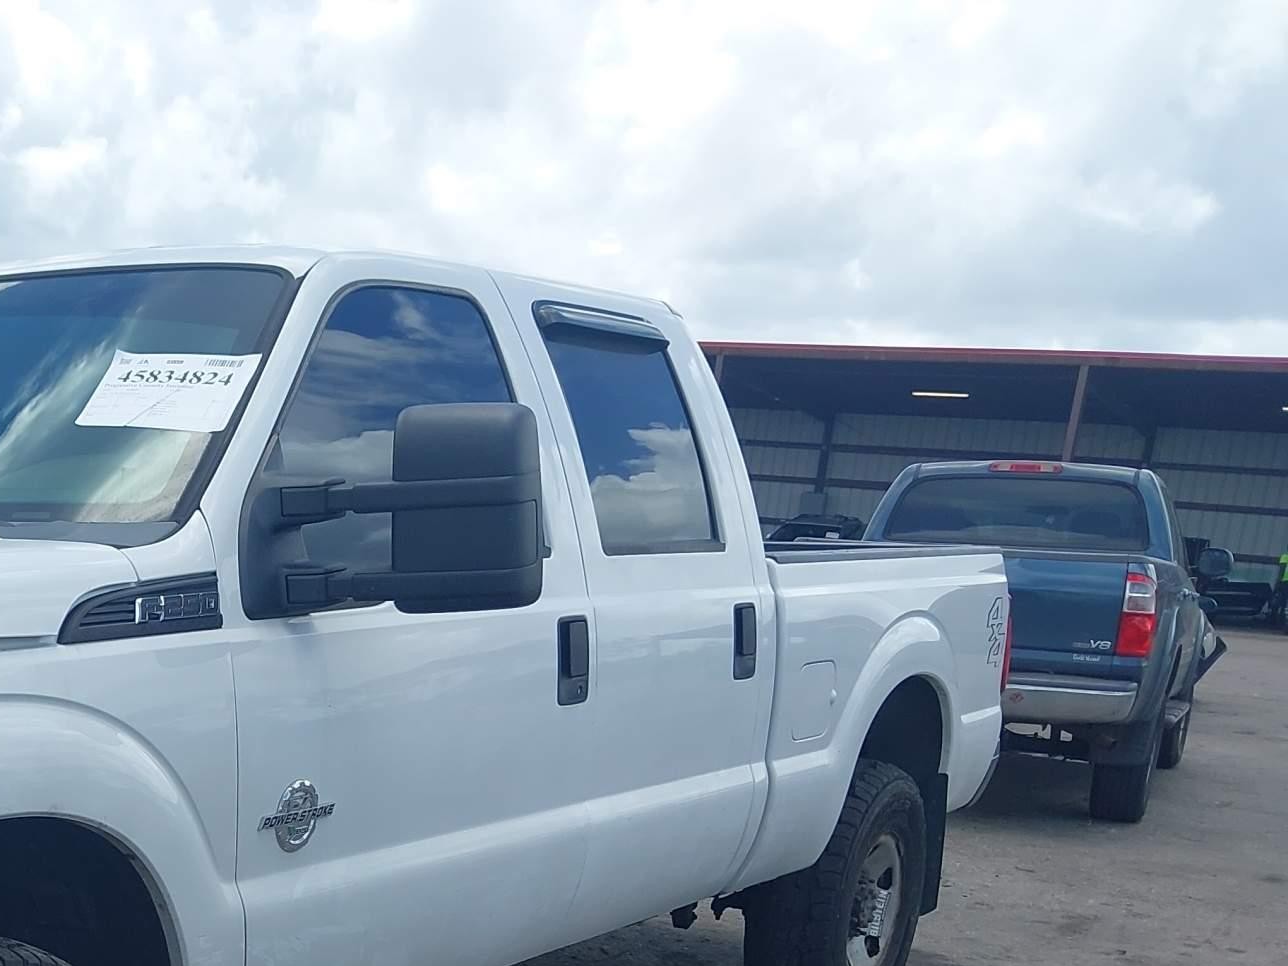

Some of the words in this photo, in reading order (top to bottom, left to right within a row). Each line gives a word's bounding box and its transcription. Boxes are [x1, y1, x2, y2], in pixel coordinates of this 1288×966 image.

[118, 369, 234, 386] 45834824
[1089, 639, 1112, 650] V8
[262, 812, 299, 830] POWER
[296, 803, 336, 822] STROKE
[869, 890, 888, 937] BILSTEIN
